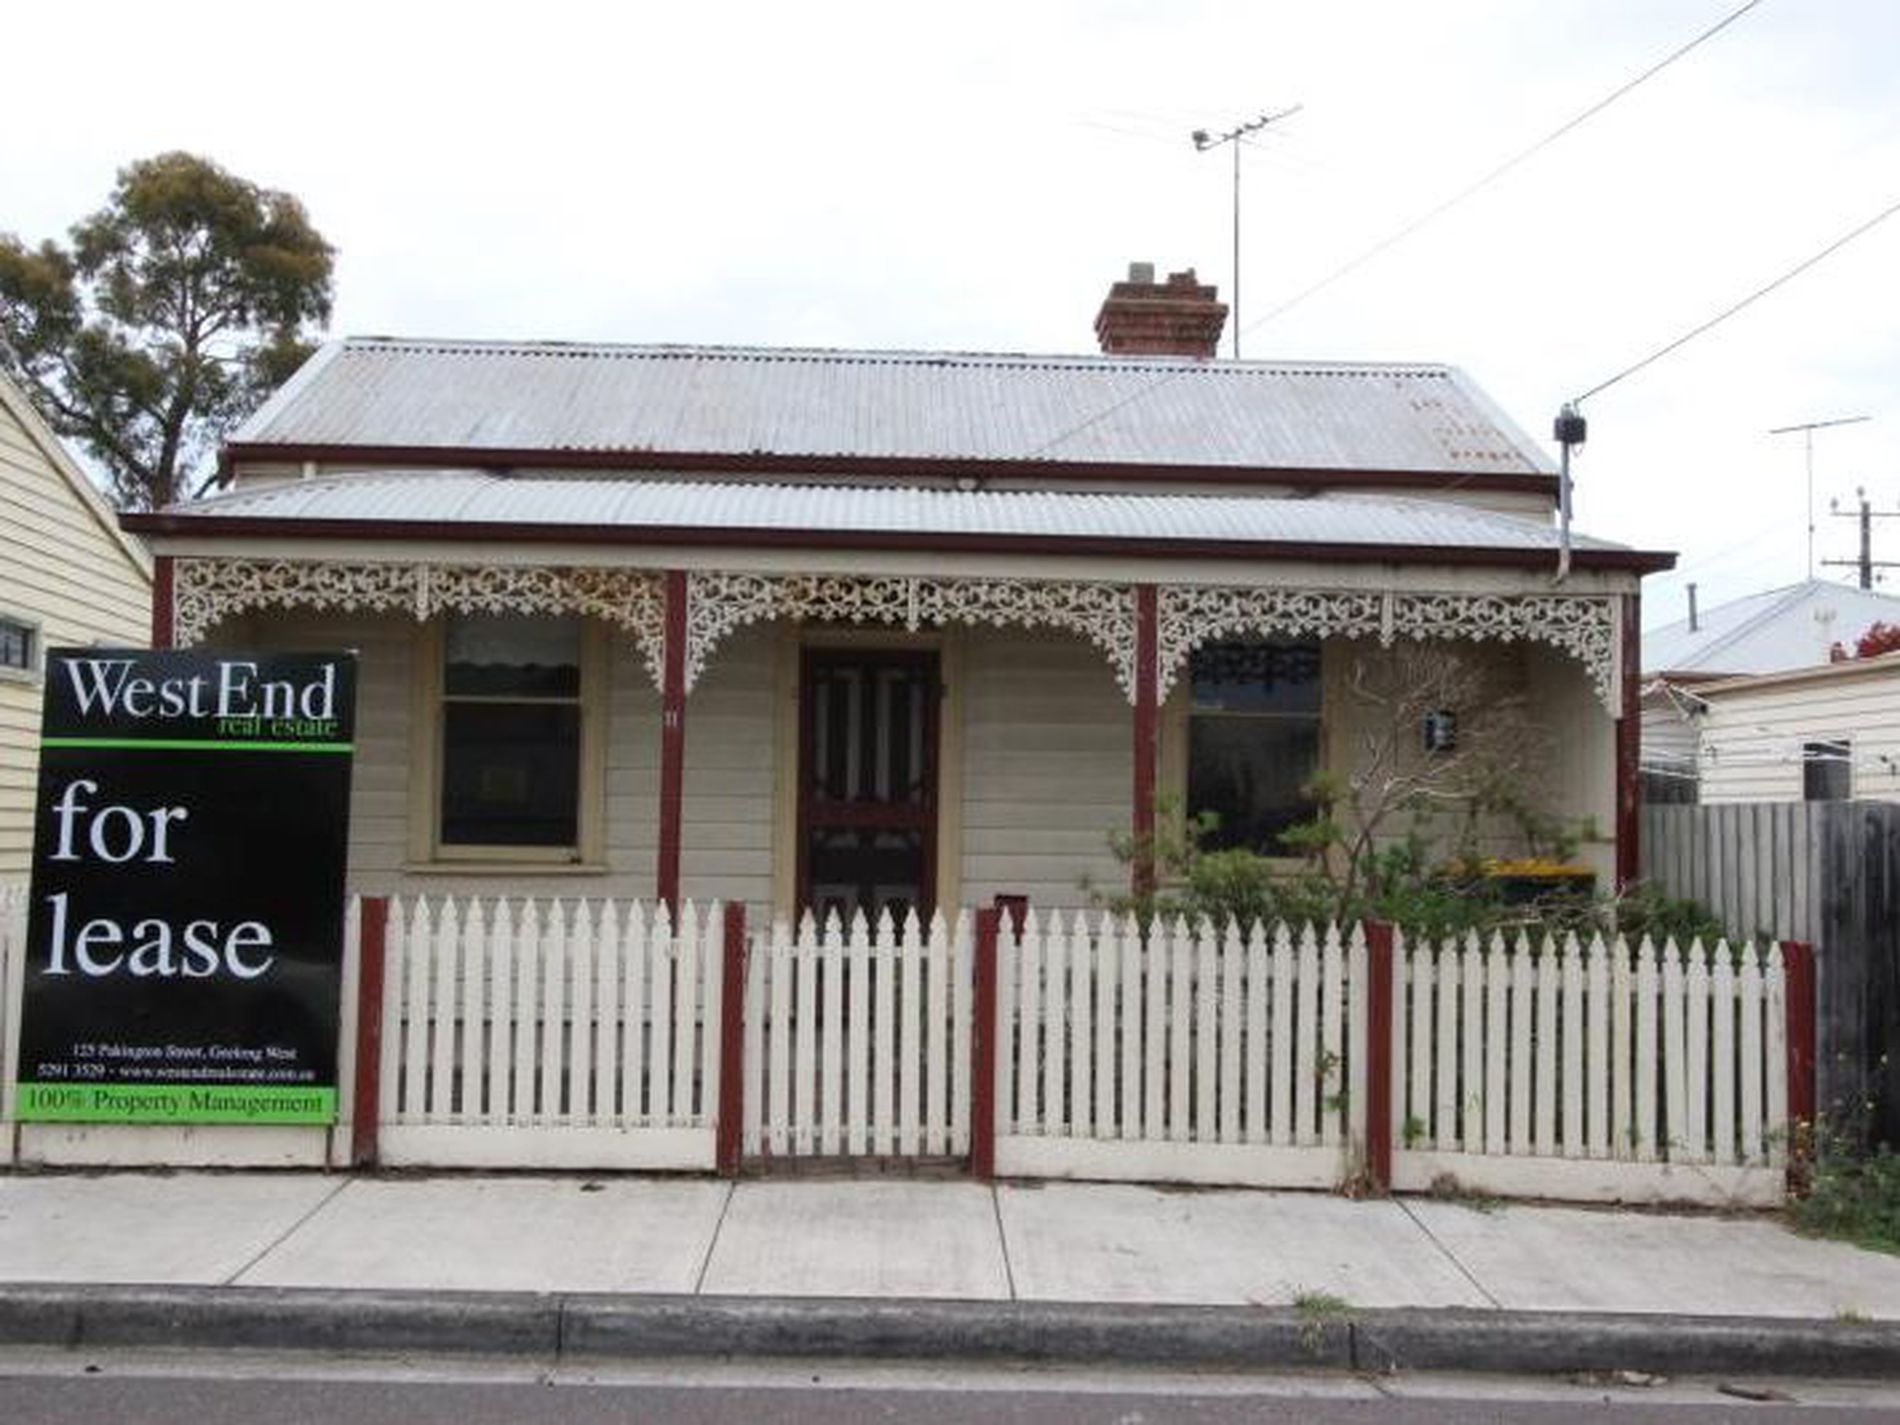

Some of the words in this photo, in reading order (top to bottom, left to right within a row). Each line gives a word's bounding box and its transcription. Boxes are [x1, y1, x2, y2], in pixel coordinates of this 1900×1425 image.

[217, 717, 258, 735] real
[271, 719, 338, 736] estate
[50, 779, 190, 862] for
[42, 892, 274, 978] lease
[30, 1088, 86, 1109] 100%
[95, 1089, 179, 1115] Property
[189, 1090, 323, 1117] Management
